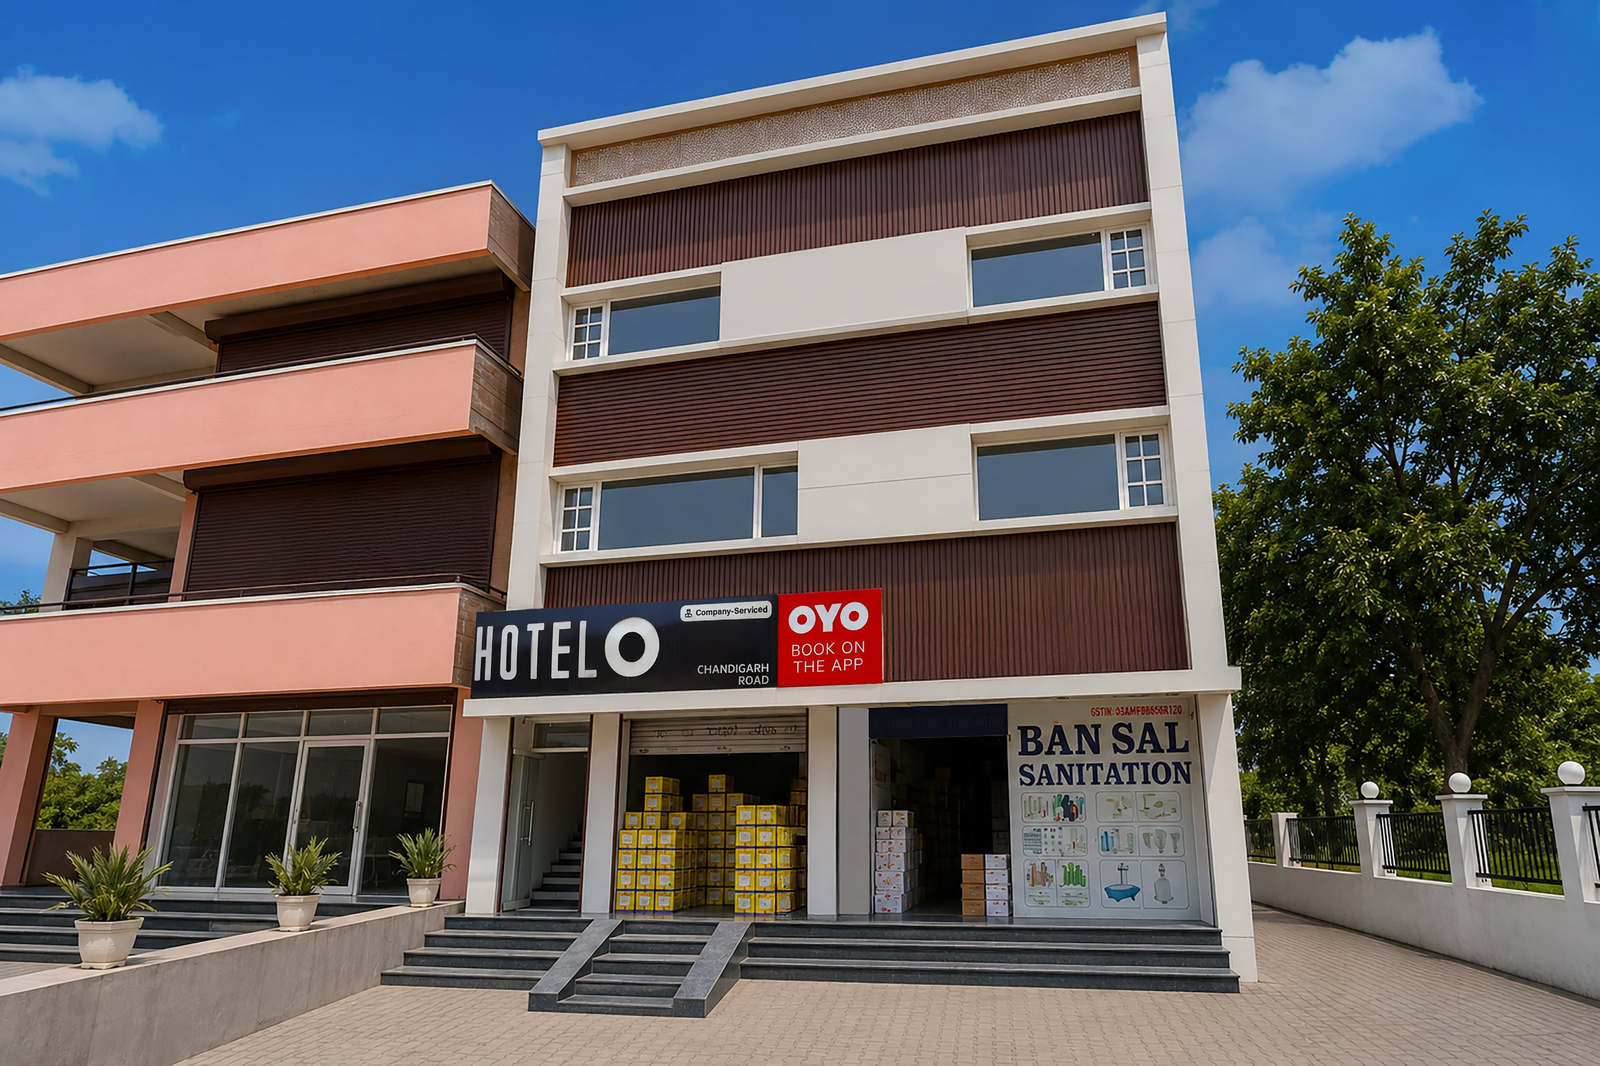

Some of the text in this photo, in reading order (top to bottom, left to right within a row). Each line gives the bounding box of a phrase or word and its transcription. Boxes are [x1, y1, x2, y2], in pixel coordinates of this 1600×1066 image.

[695, 605, 768, 617] Company-Serviced
[788, 601, 869, 634] OYO
[474, 620, 597, 681] HOTEL
[791, 640, 865, 657] BOOK ON
[697, 663, 769, 675] CHANDIGARH
[793, 657, 864, 673] THE APP
[738, 675, 769, 686] ROAD
[1018, 761, 1192, 786] SANITATION
